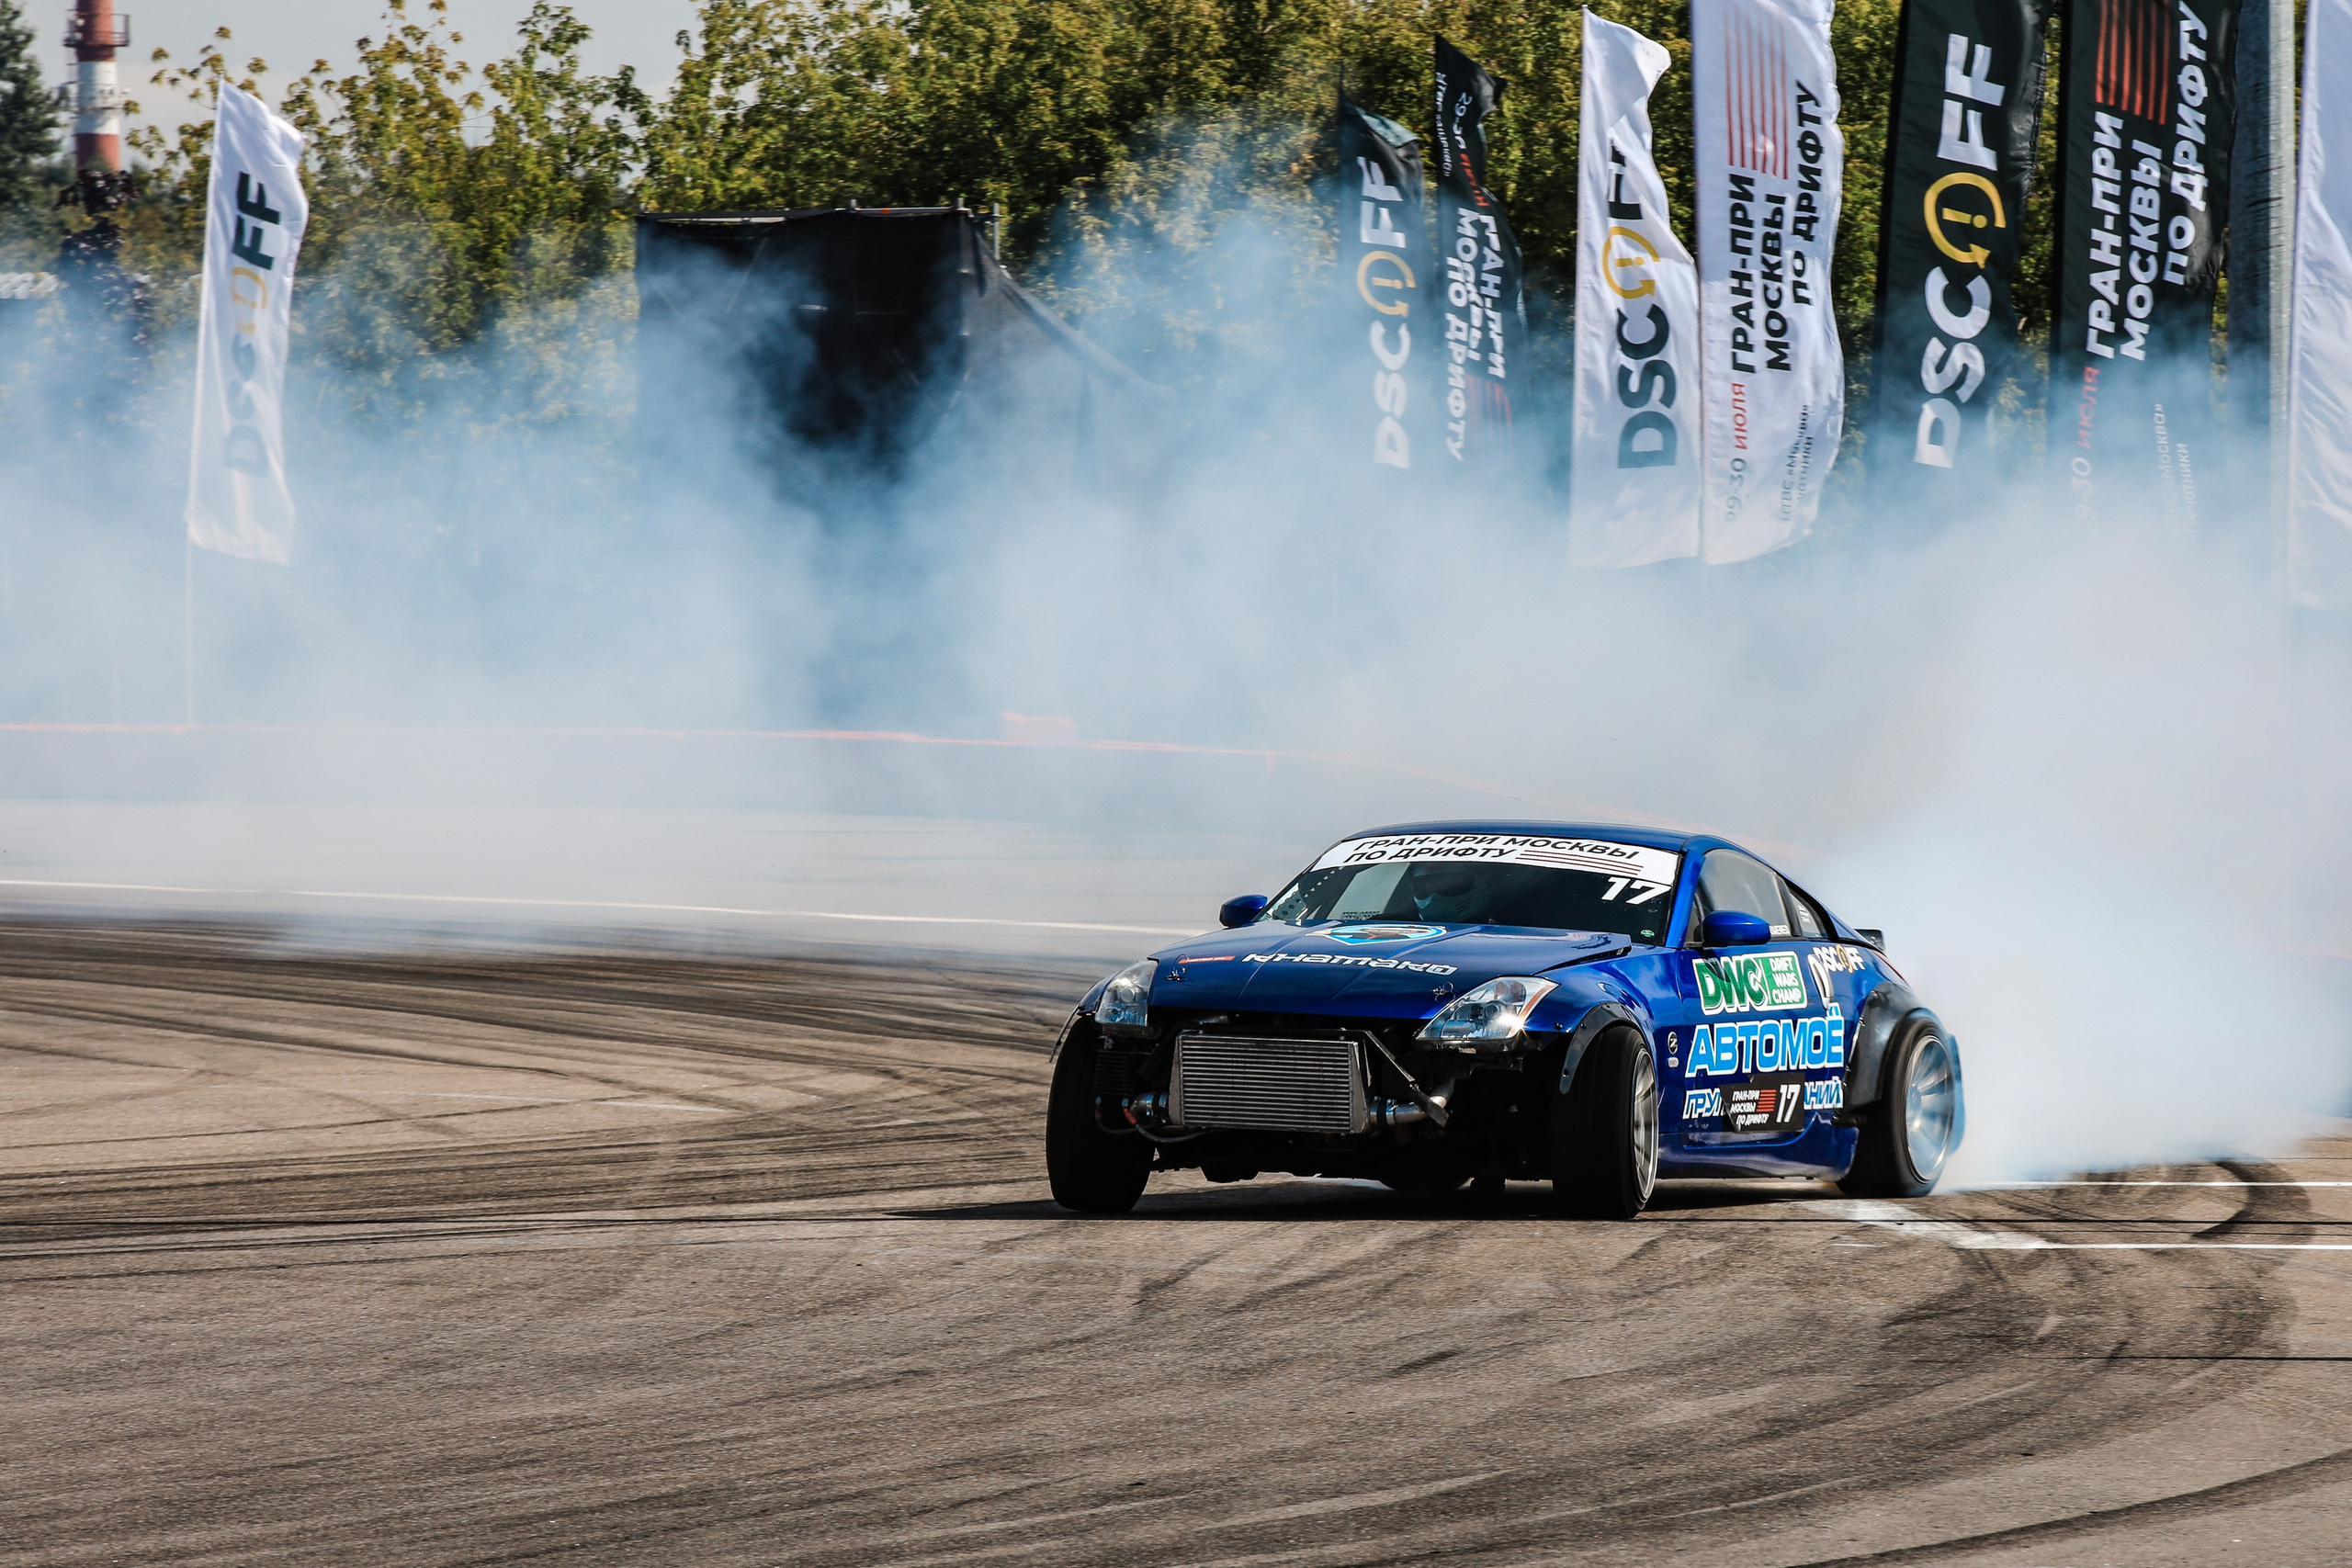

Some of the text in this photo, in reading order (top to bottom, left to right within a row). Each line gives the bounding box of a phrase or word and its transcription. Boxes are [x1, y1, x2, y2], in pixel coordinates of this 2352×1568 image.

[2163, 0, 2209, 285] ПО ДРИФТУ
[1790, 80, 1822, 306] ПО ДРИФТУ
[1914, 33, 2006, 468] DSCOFF
[2086, 111, 2123, 359] ГРАН-ПРИ
[2120, 139, 2163, 361] МОСКВЫ
[1729, 173, 1756, 374] ГРАН-ПРИ
[1764, 194, 1792, 371] МОСКВЫ
[1445, 256, 1470, 462] ПО ДРИФТУ
[1733, 382, 1747, 449] ИЮЛЯ
[2075, 367, 2100, 449] ИЮЛЯ
[1343, 847, 1517, 863] ПО ДРИФТУ
[1353, 835, 1640, 860] ГРАН-ПРИ МОСКВЫ
[1600, 876, 1672, 905] 17
[1693, 956, 1767, 1014] DWC
[1769, 956, 1793, 972] DRIFT
[1772, 972, 1800, 988] WARS
[1772, 987, 1802, 1004] CHAMP
[1730, 1101, 1757, 1113] МОСКВЫ
[1732, 1089, 1760, 1101] ГРАН-ПРИ
[1776, 1084, 1801, 1123] 17
